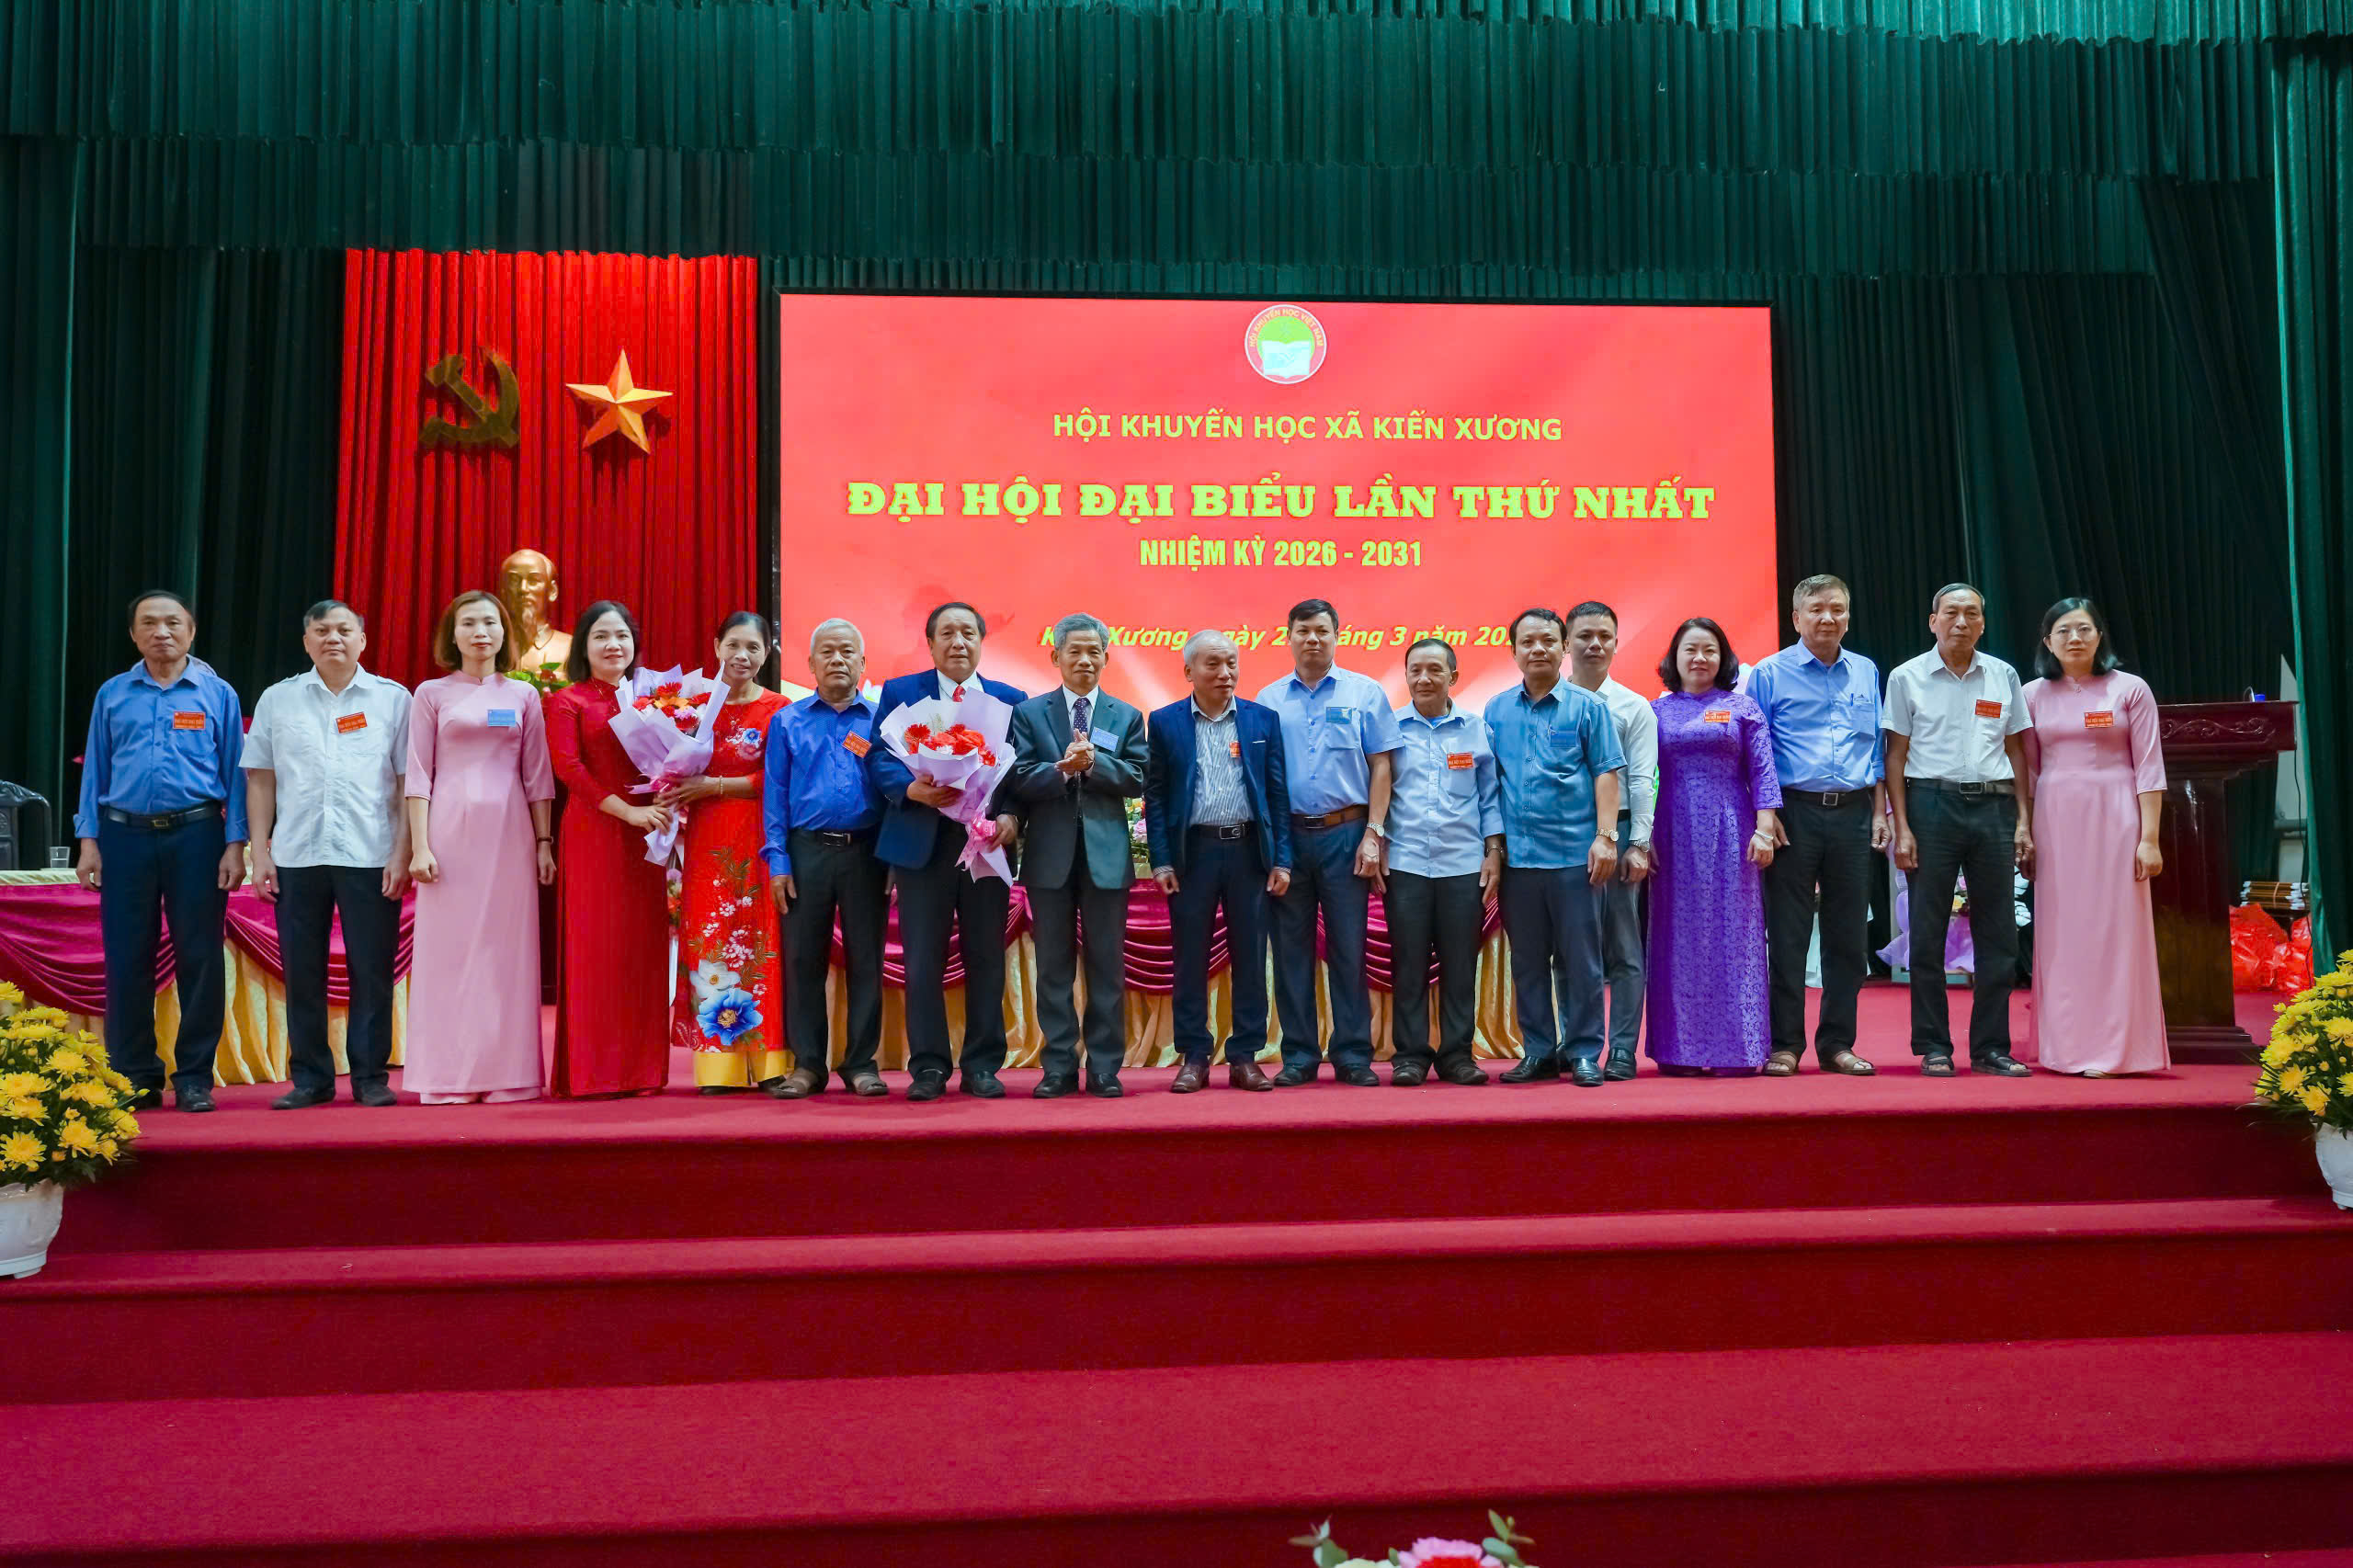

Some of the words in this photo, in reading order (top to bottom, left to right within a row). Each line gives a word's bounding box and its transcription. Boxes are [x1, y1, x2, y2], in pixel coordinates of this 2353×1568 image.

[1053, 407, 1111, 442] HỘI
[1121, 408, 1244, 438] KHUYẾN
[1254, 415, 1316, 444] HỌC
[1324, 410, 1364, 439] XÃ
[1373, 410, 1444, 440] KIẾN
[1455, 414, 1562, 441] XƯƠNG
[847, 482, 945, 523] ĐẠI
[961, 475, 1062, 524] HỘI
[1079, 483, 1174, 524] ĐẠI
[1190, 472, 1316, 517] BIỂU
[1334, 472, 1437, 518] LẦN
[1452, 479, 1561, 519] THỨ
[1573, 476, 1715, 519] NHẤT
[1140, 534, 1226, 572] NHIỆM
[1233, 534, 1267, 566] KỲ
[1273, 540, 1337, 567] 2026
[1361, 540, 1421, 567] 2031
[1337, 624, 1384, 651] áng
[1389, 626, 1408, 646] 3
